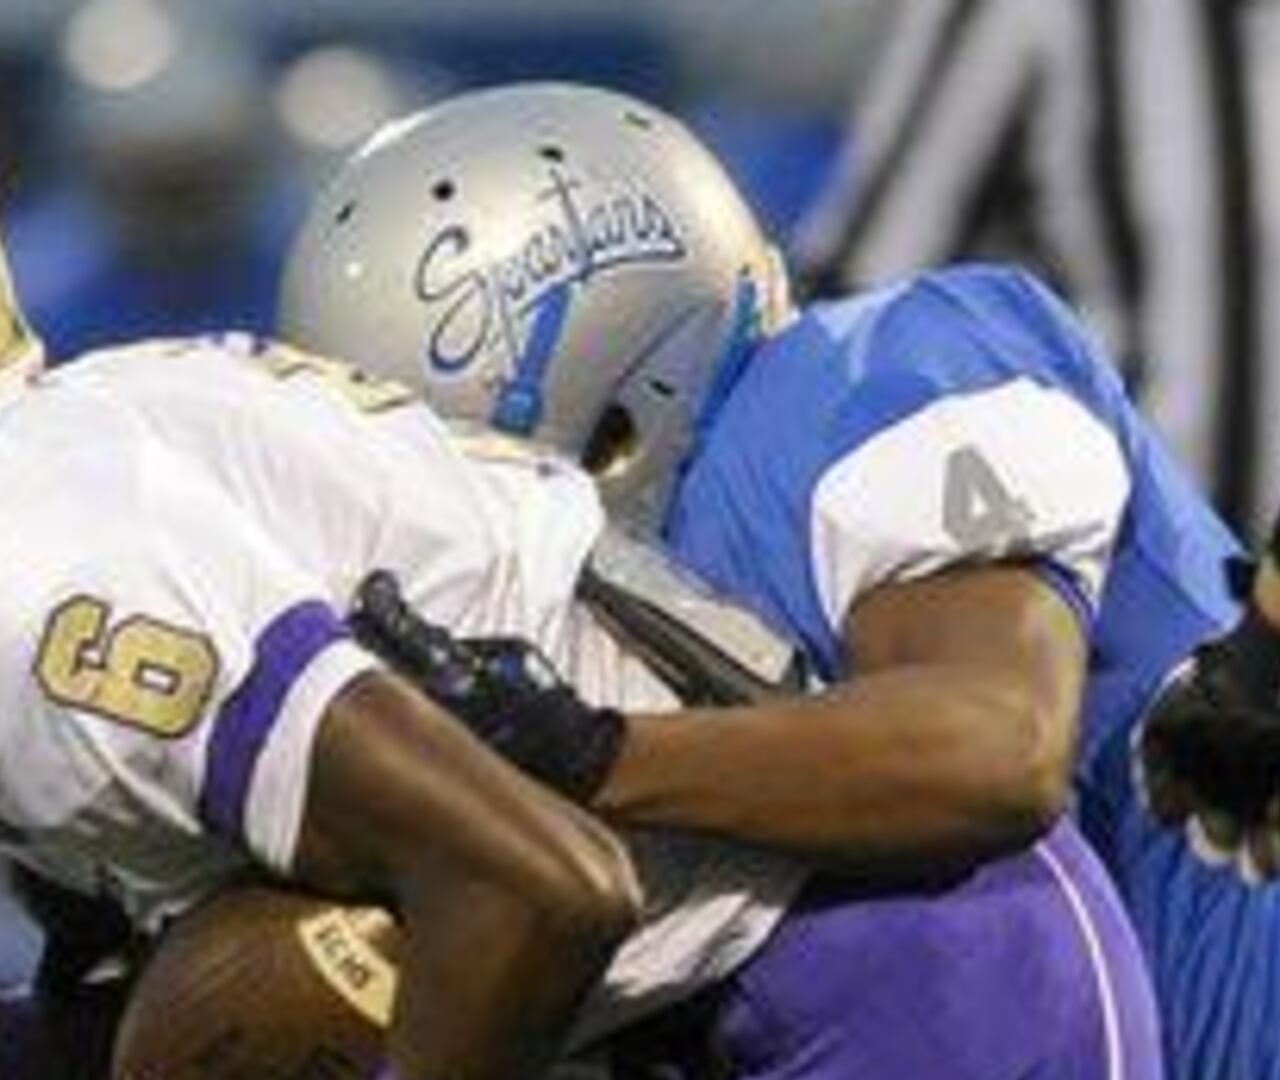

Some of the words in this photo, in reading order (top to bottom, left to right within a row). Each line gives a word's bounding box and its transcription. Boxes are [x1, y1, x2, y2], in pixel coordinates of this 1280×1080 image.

[414, 168, 687, 377] Spartans
[941, 445, 1038, 550] 4
[33, 594, 218, 739] 6
